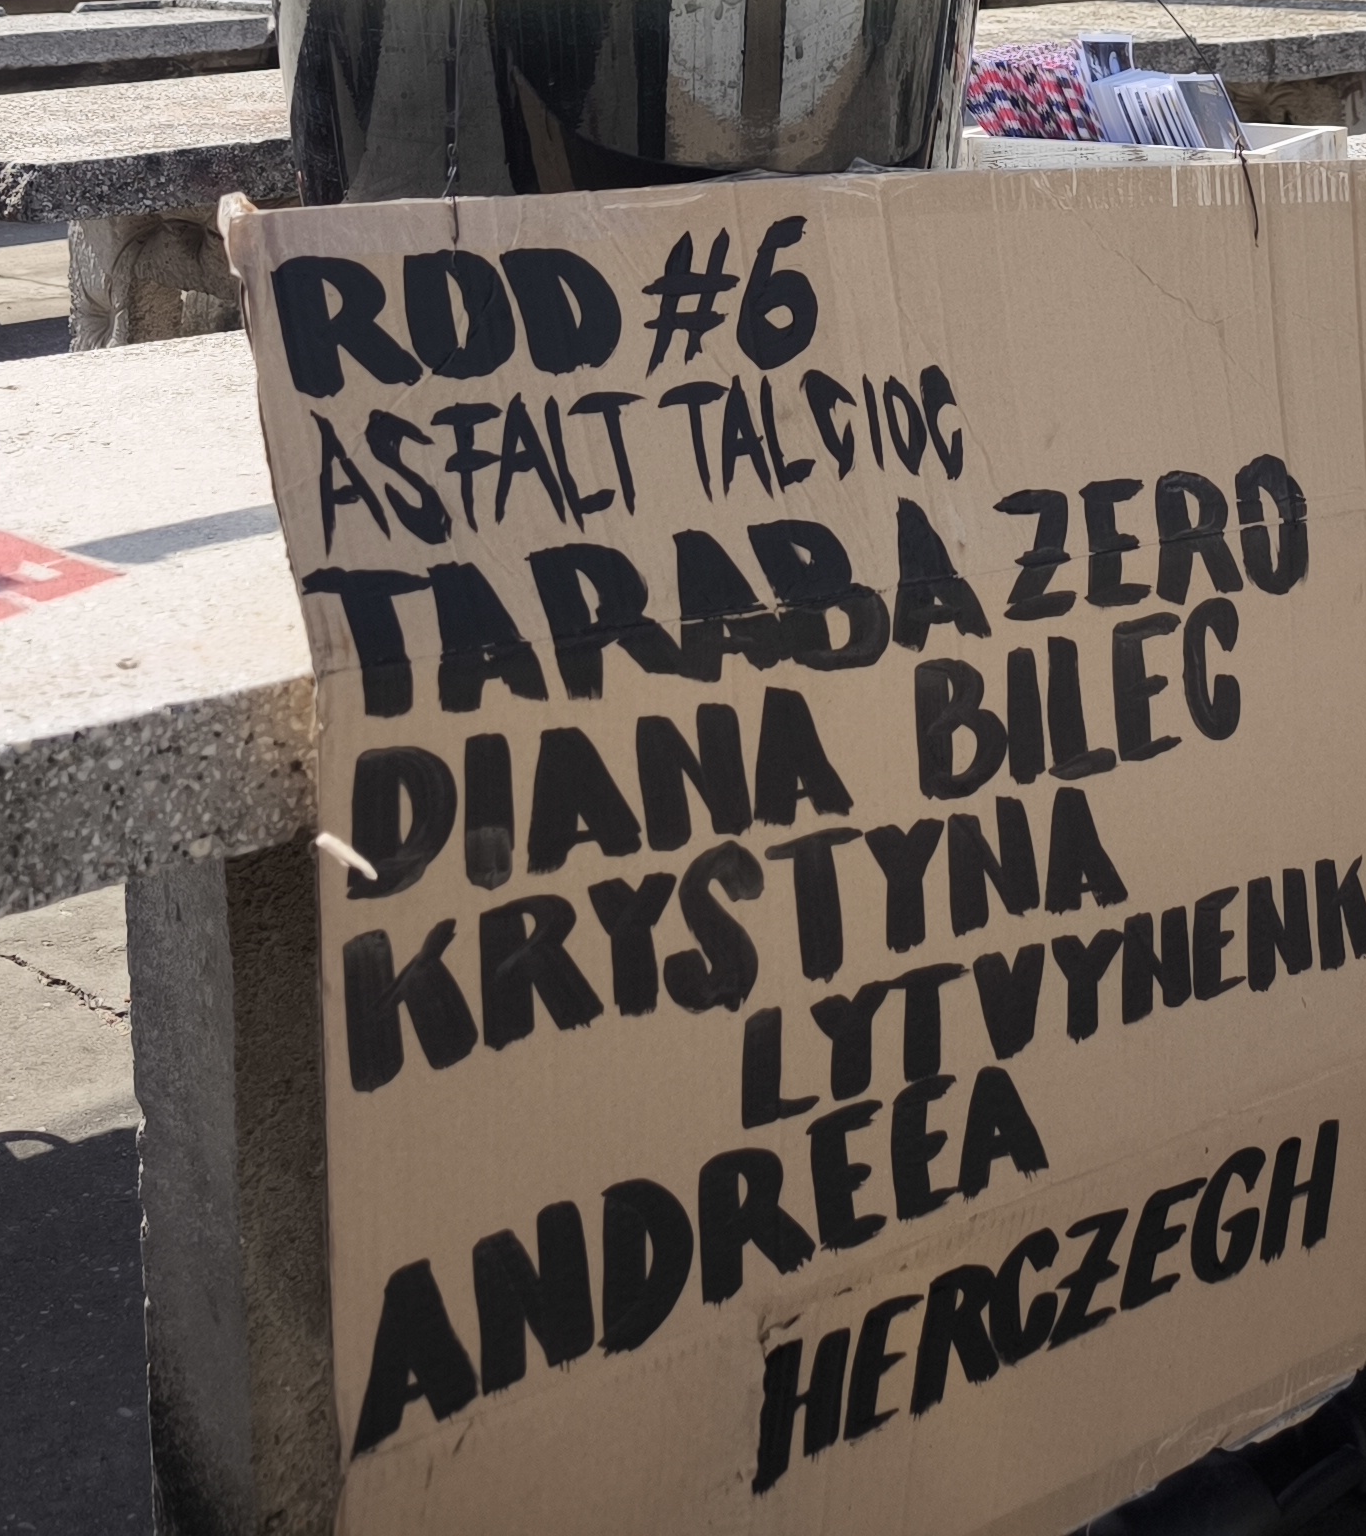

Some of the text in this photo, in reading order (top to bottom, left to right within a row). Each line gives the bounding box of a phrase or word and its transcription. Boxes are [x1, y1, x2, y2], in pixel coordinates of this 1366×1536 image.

[270, 214, 818, 398] ROD #6
[302, 454, 1309, 718] TARABA ZERO
[311, 365, 965, 555] ASFALT TALCIOC
[347, 598, 1241, 899] DIANA BILEC
[343, 787, 1128, 1092] KRYSTYNA
[347, 1067, 1049, 1467] ANDREEA
[751, 1119, 1339, 1497] HERCZEGH
